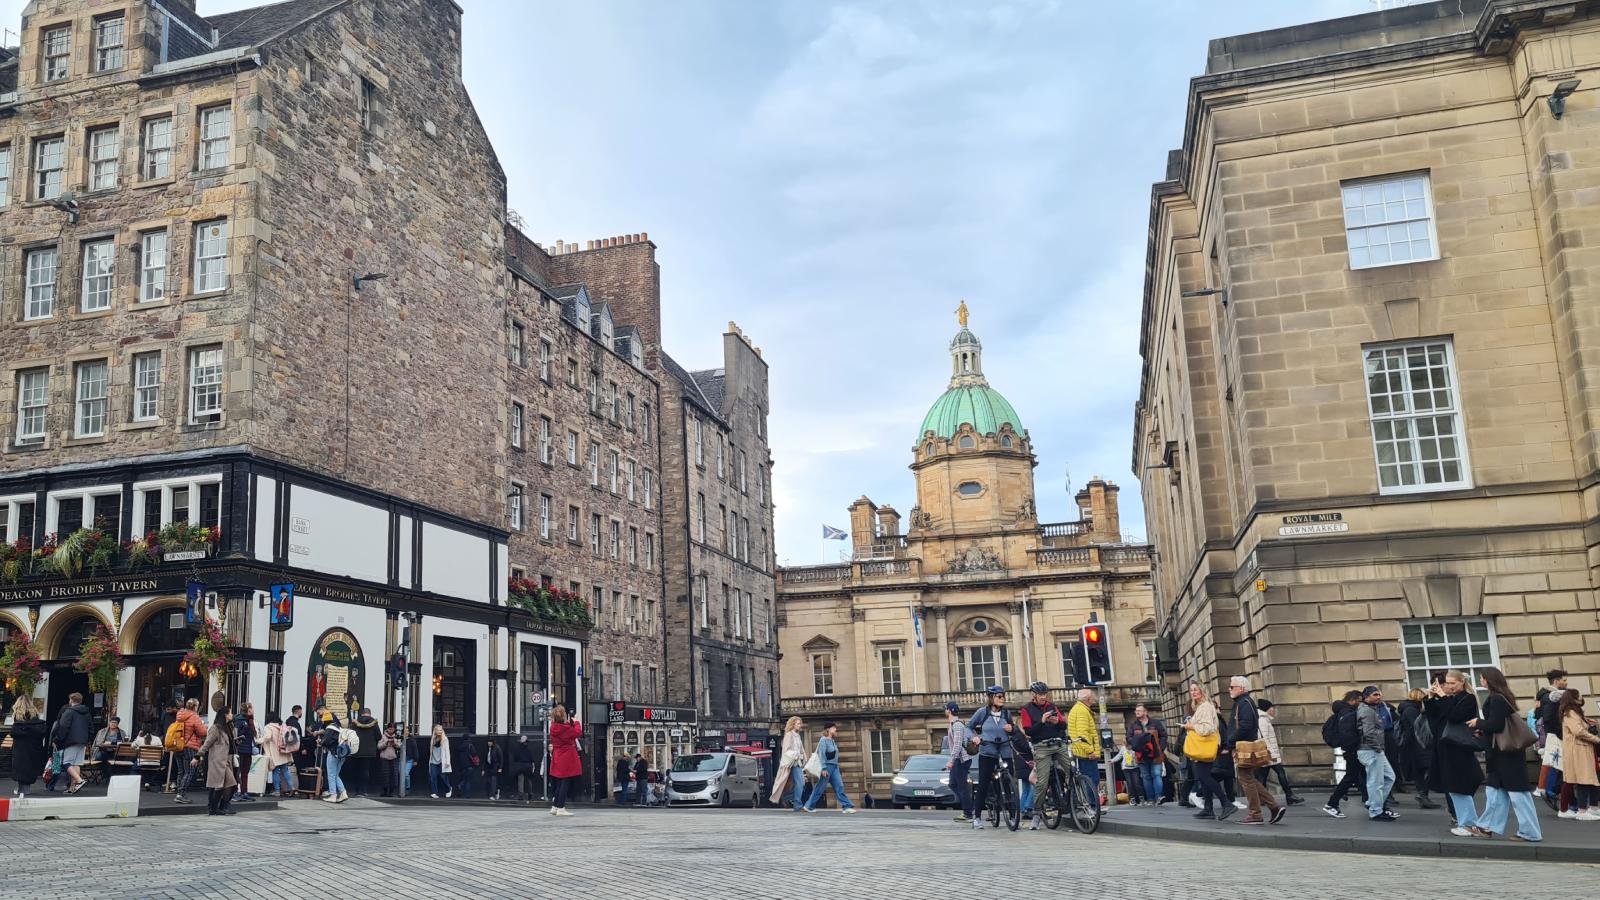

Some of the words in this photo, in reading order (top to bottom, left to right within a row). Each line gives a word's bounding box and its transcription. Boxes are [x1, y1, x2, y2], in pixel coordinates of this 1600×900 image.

[1286, 516, 1313, 524] ROYAL
[1283, 525, 1343, 534] LAWNMARKET
[51, 584, 104, 597] BRODIE'S
[110, 580, 158, 592] TAVERN
[293, 583, 321, 594] EACON
[325, 587, 360, 601] BRODIE'S
[363, 593, 391, 605] TAVERN
[610, 702, 614, 711] I
[651, 709, 676, 720] SCOTLAND
